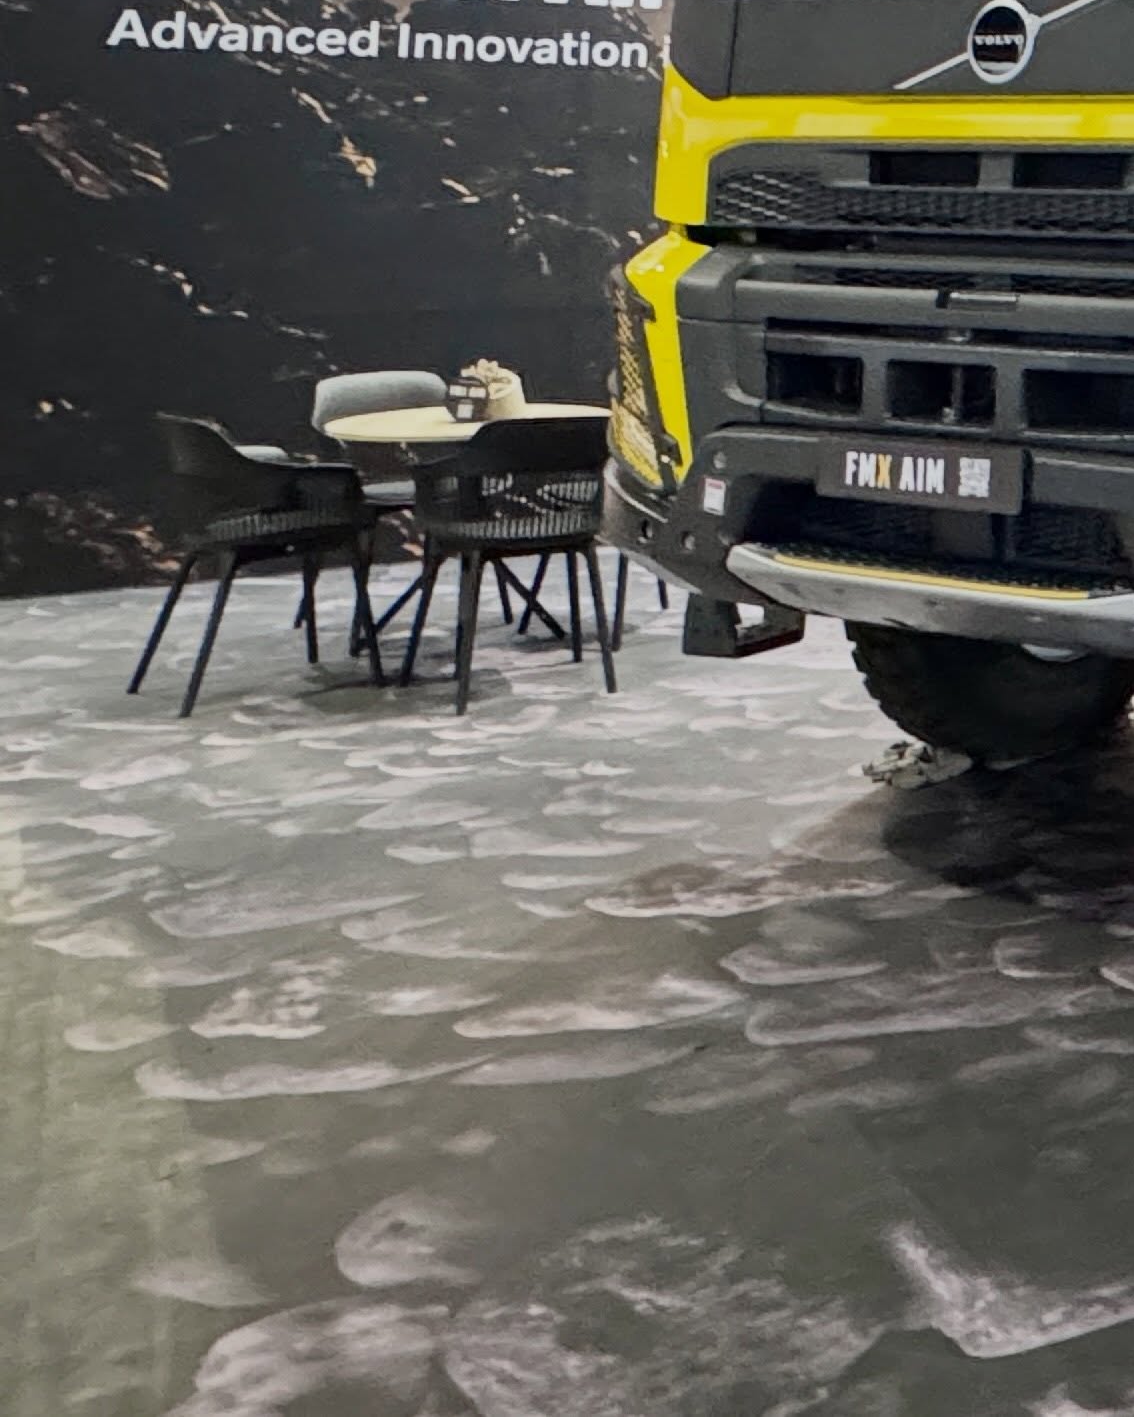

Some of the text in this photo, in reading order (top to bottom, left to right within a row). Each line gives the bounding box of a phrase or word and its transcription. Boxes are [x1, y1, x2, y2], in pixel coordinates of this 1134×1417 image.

[105, 8, 382, 58] Advanced
[398, 22, 649, 68] Innovation
[845, 450, 945, 495] FMX AIM
